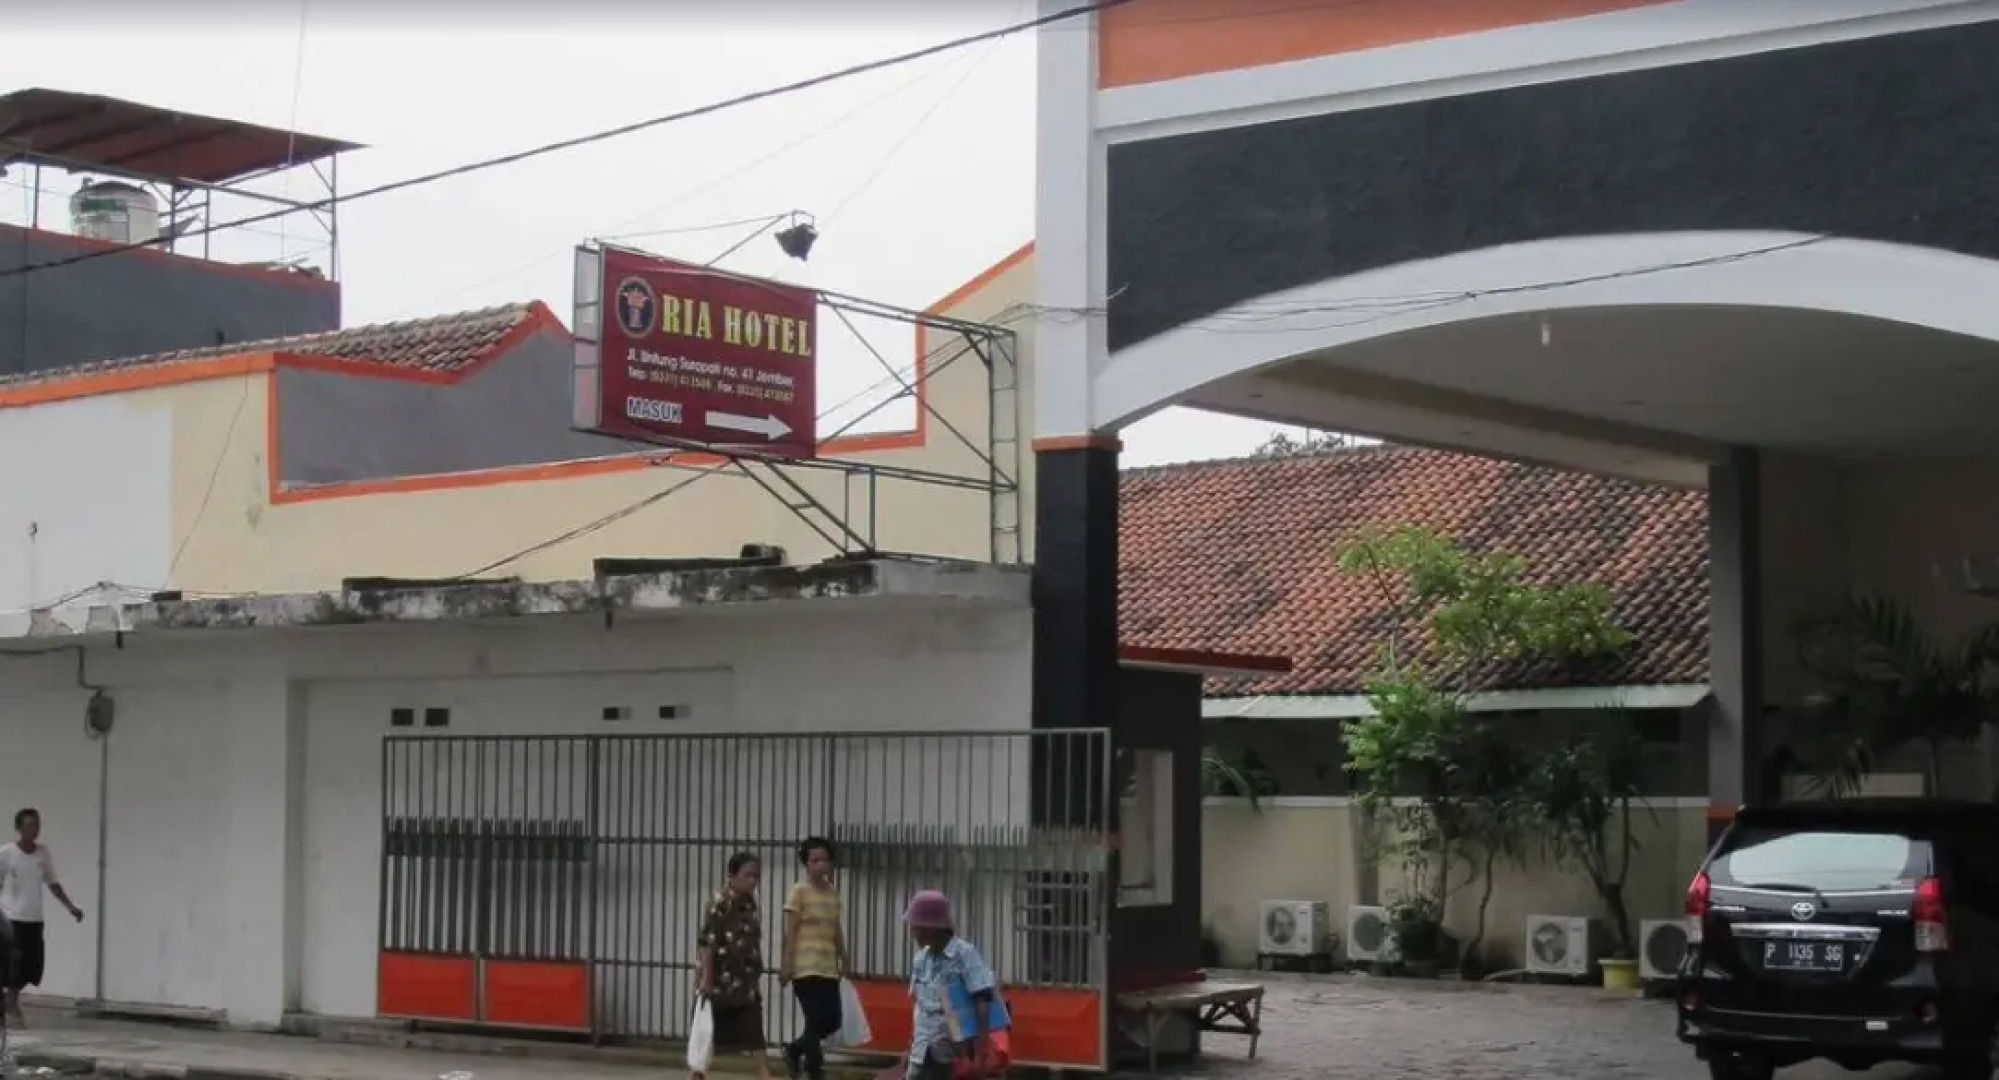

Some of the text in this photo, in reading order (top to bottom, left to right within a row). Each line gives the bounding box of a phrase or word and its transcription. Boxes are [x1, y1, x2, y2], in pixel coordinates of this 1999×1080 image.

[662, 293, 812, 357] RIA HOTEL
[627, 396, 682, 424] MASUK
[1766, 942, 1777, 959] P
[1824, 944, 1841, 961] SG
